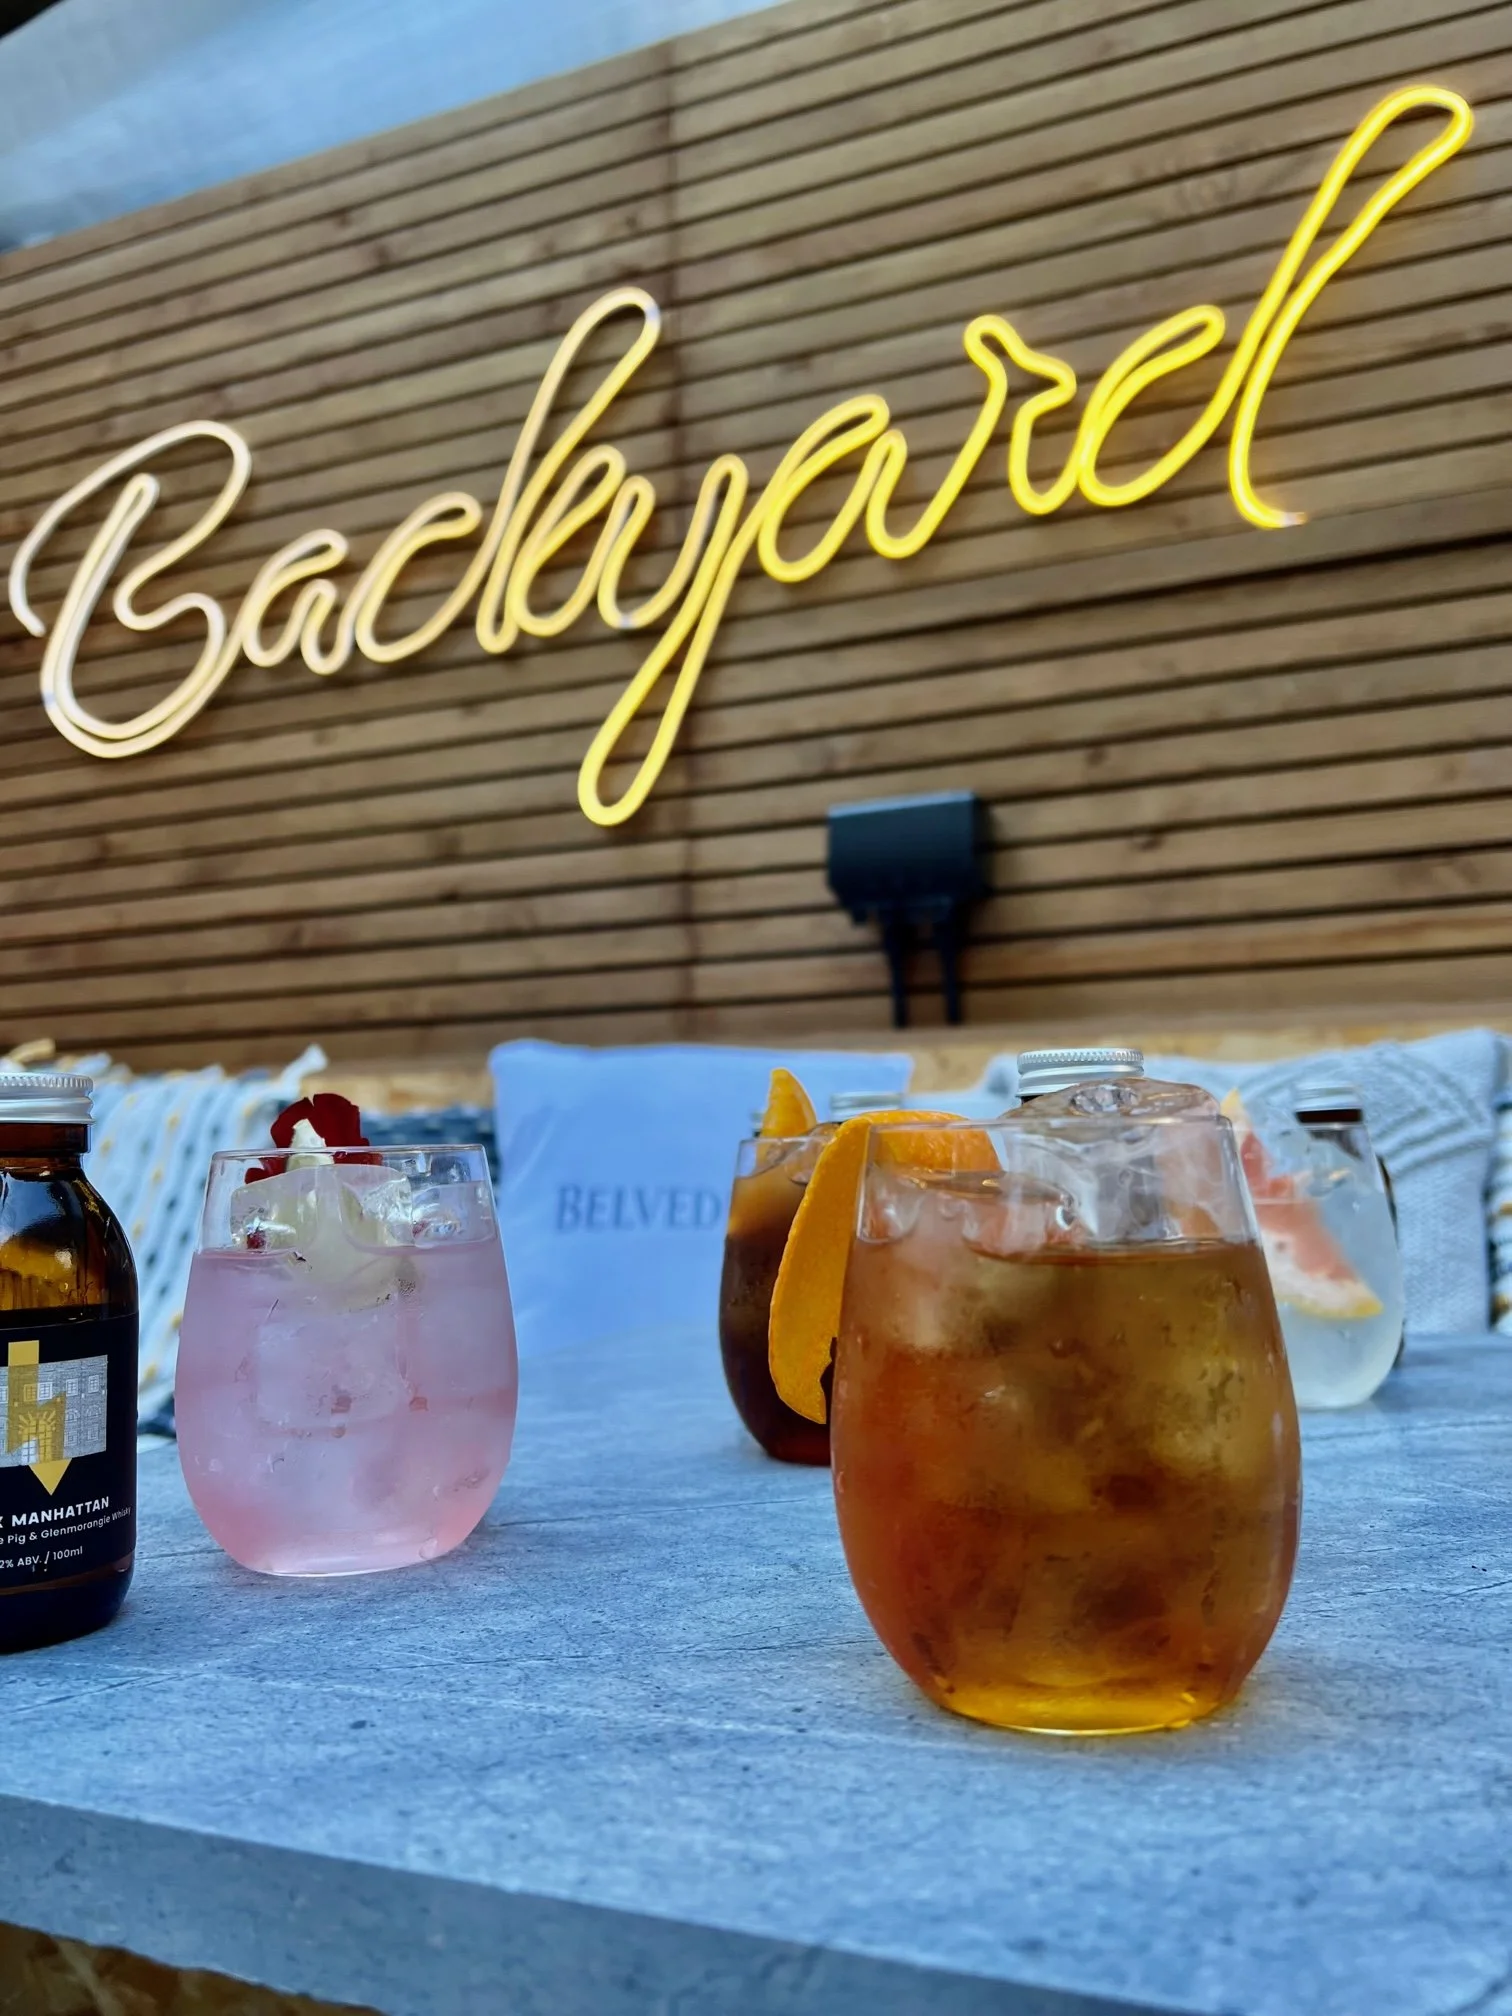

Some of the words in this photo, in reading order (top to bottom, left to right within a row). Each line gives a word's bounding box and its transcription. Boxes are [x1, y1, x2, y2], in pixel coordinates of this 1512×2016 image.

[8, 83, 1474, 827] Backyard
[7, 1533, 26, 1545] Pig
[29, 1531, 38, 1541] &
[41, 1515, 111, 1539] Glenmorangie
[111, 1506, 132, 1521] Whisky
[11, 1496, 110, 1527] MANHATTAN
[52, 1545, 83, 1560] 100ml
